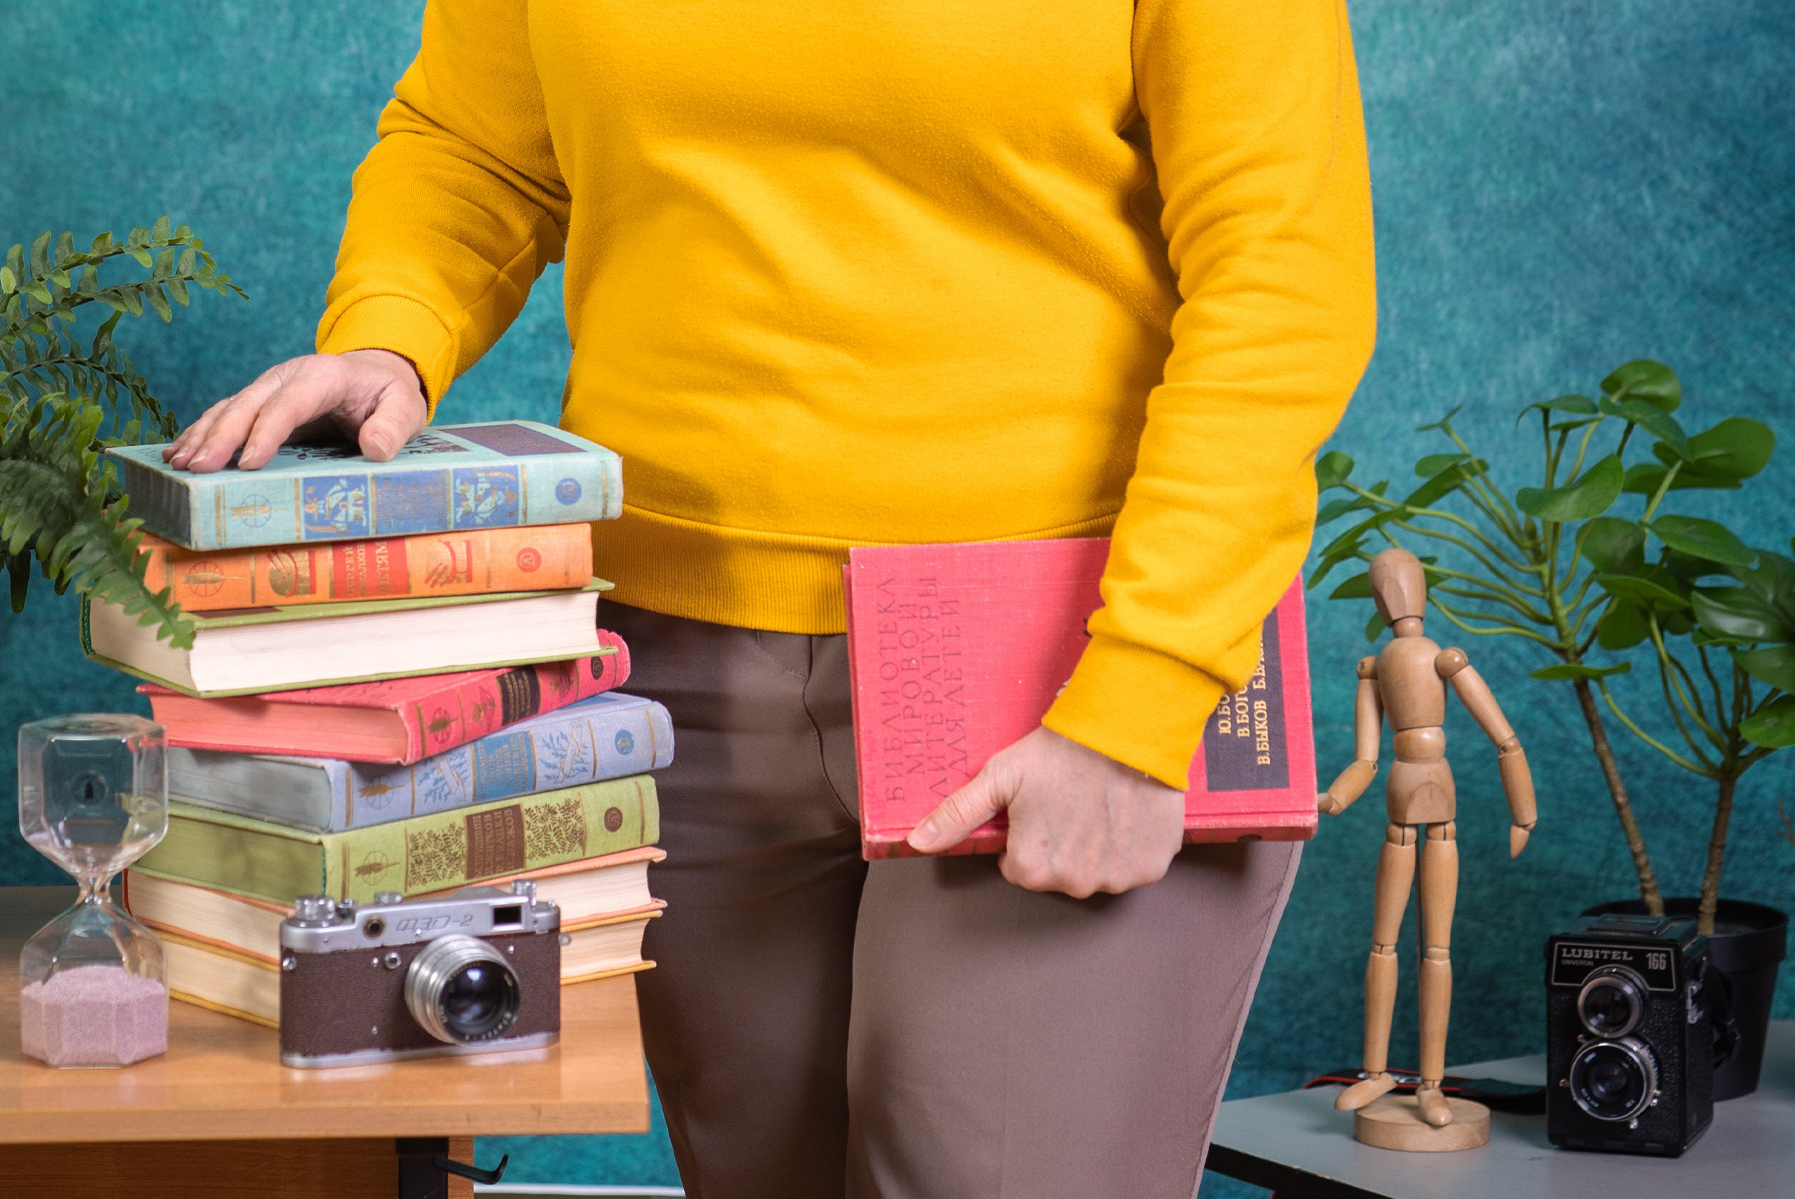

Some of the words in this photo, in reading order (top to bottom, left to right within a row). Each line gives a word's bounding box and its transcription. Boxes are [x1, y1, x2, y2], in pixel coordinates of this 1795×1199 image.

[342, 545, 355, 597] СЕРГЕЙ
[375, 540, 391, 595] ДЕТЯМ
[876, 576, 905, 802] БИБЛИОТЕКА
[896, 603, 925, 775] МИРОВОЙ
[918, 576, 947, 799] ЛИТЕРАТУРЫ
[945, 717, 969, 778] ДЛЯ
[1253, 699, 1271, 766] В.БЫКОВ
[1561, 947, 1634, 962] LUBITEL
[1645, 952, 1667, 971] 166
